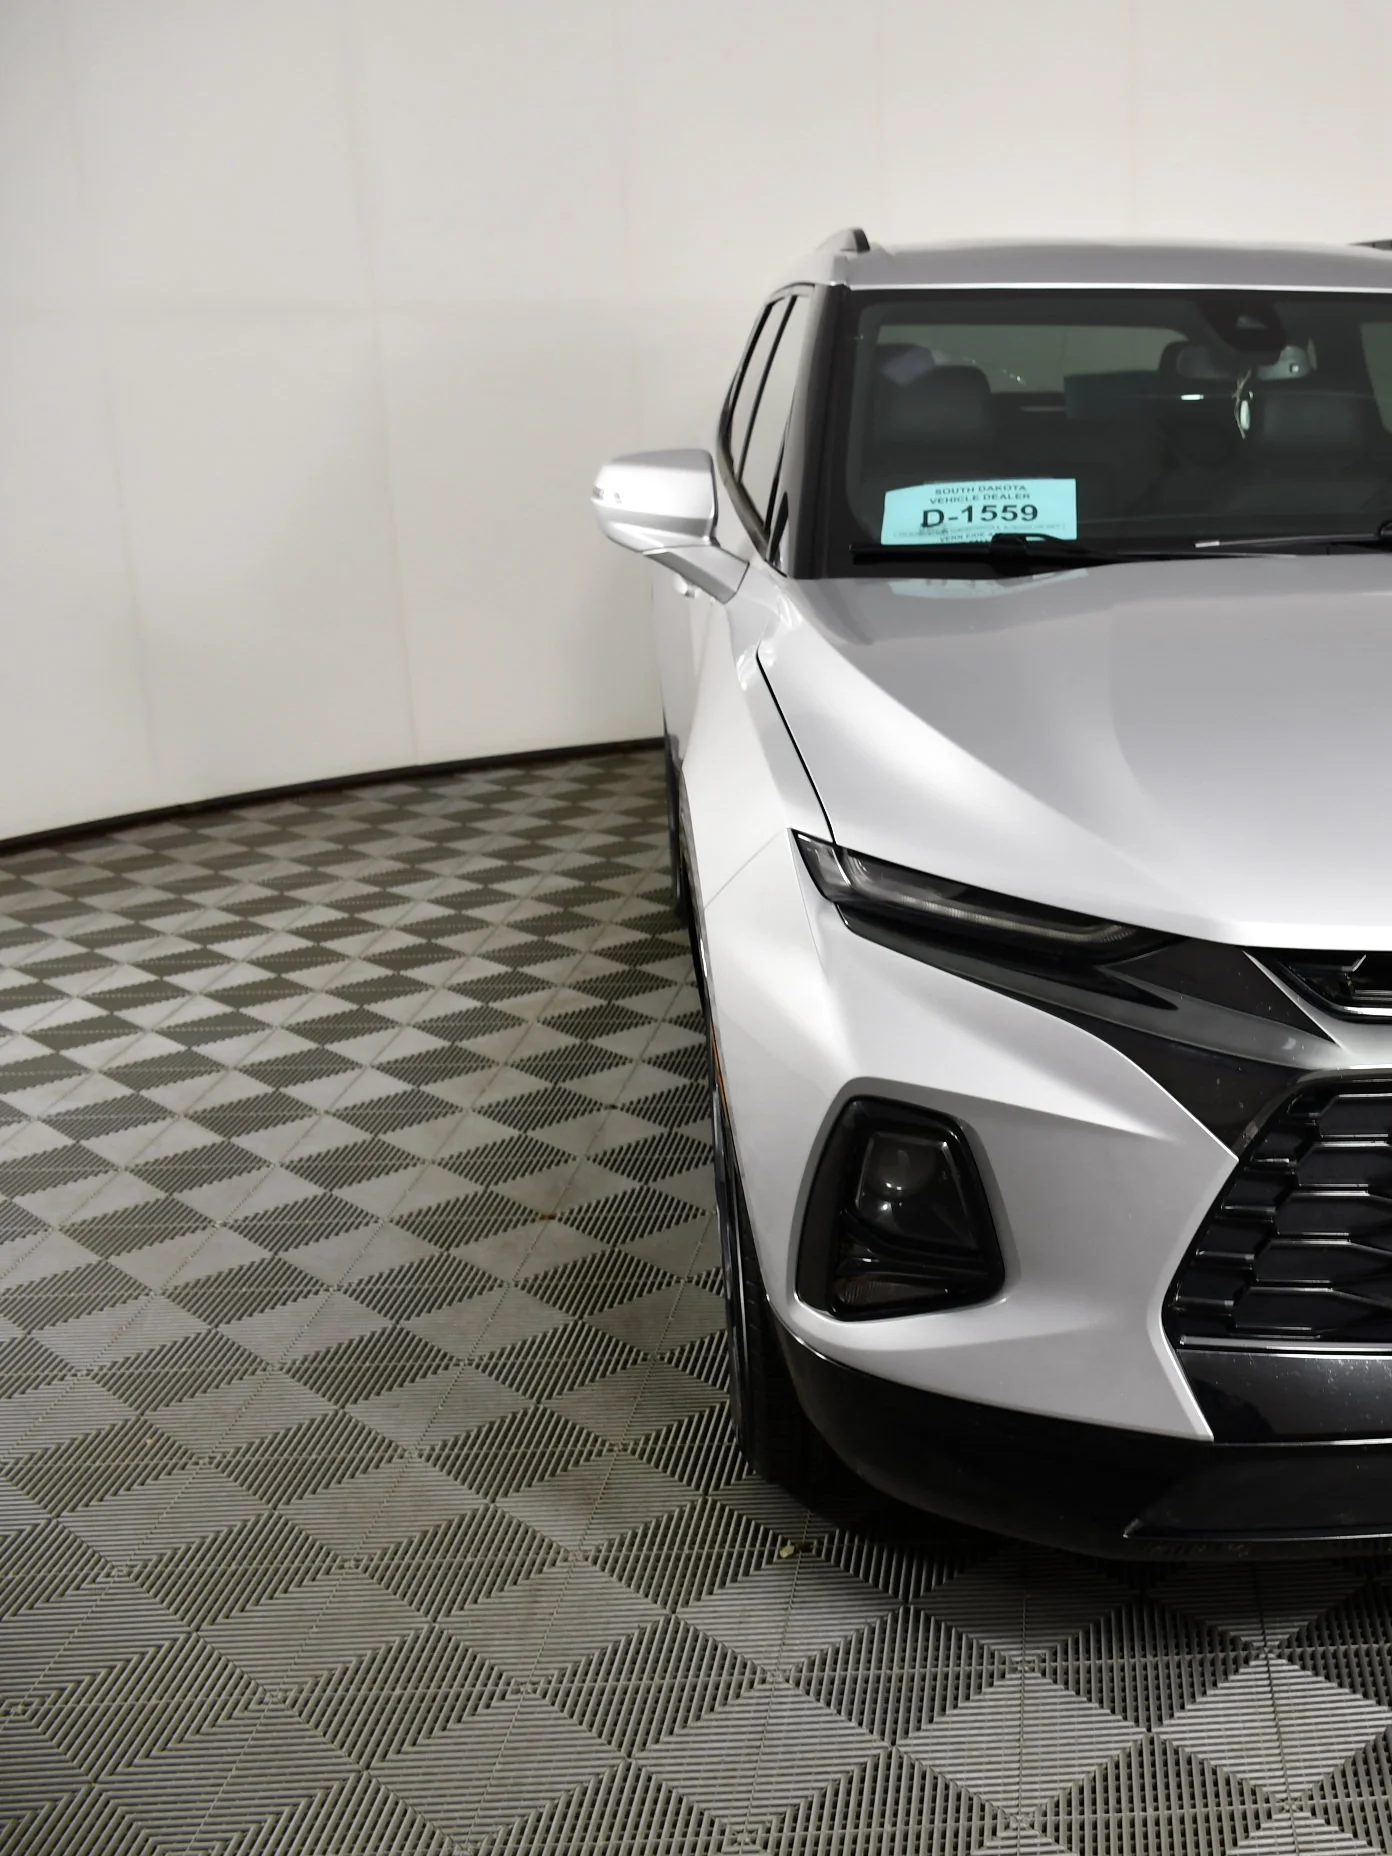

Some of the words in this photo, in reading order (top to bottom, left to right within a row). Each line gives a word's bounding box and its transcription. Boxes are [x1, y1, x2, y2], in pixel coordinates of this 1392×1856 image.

[935, 486, 975, 495] SOUTH
[978, 484, 1026, 492] DAKOTA
[929, 494, 979, 504] VEHICLE
[983, 493, 1030, 501] DEALER
[920, 504, 1038, 528] D-1559
